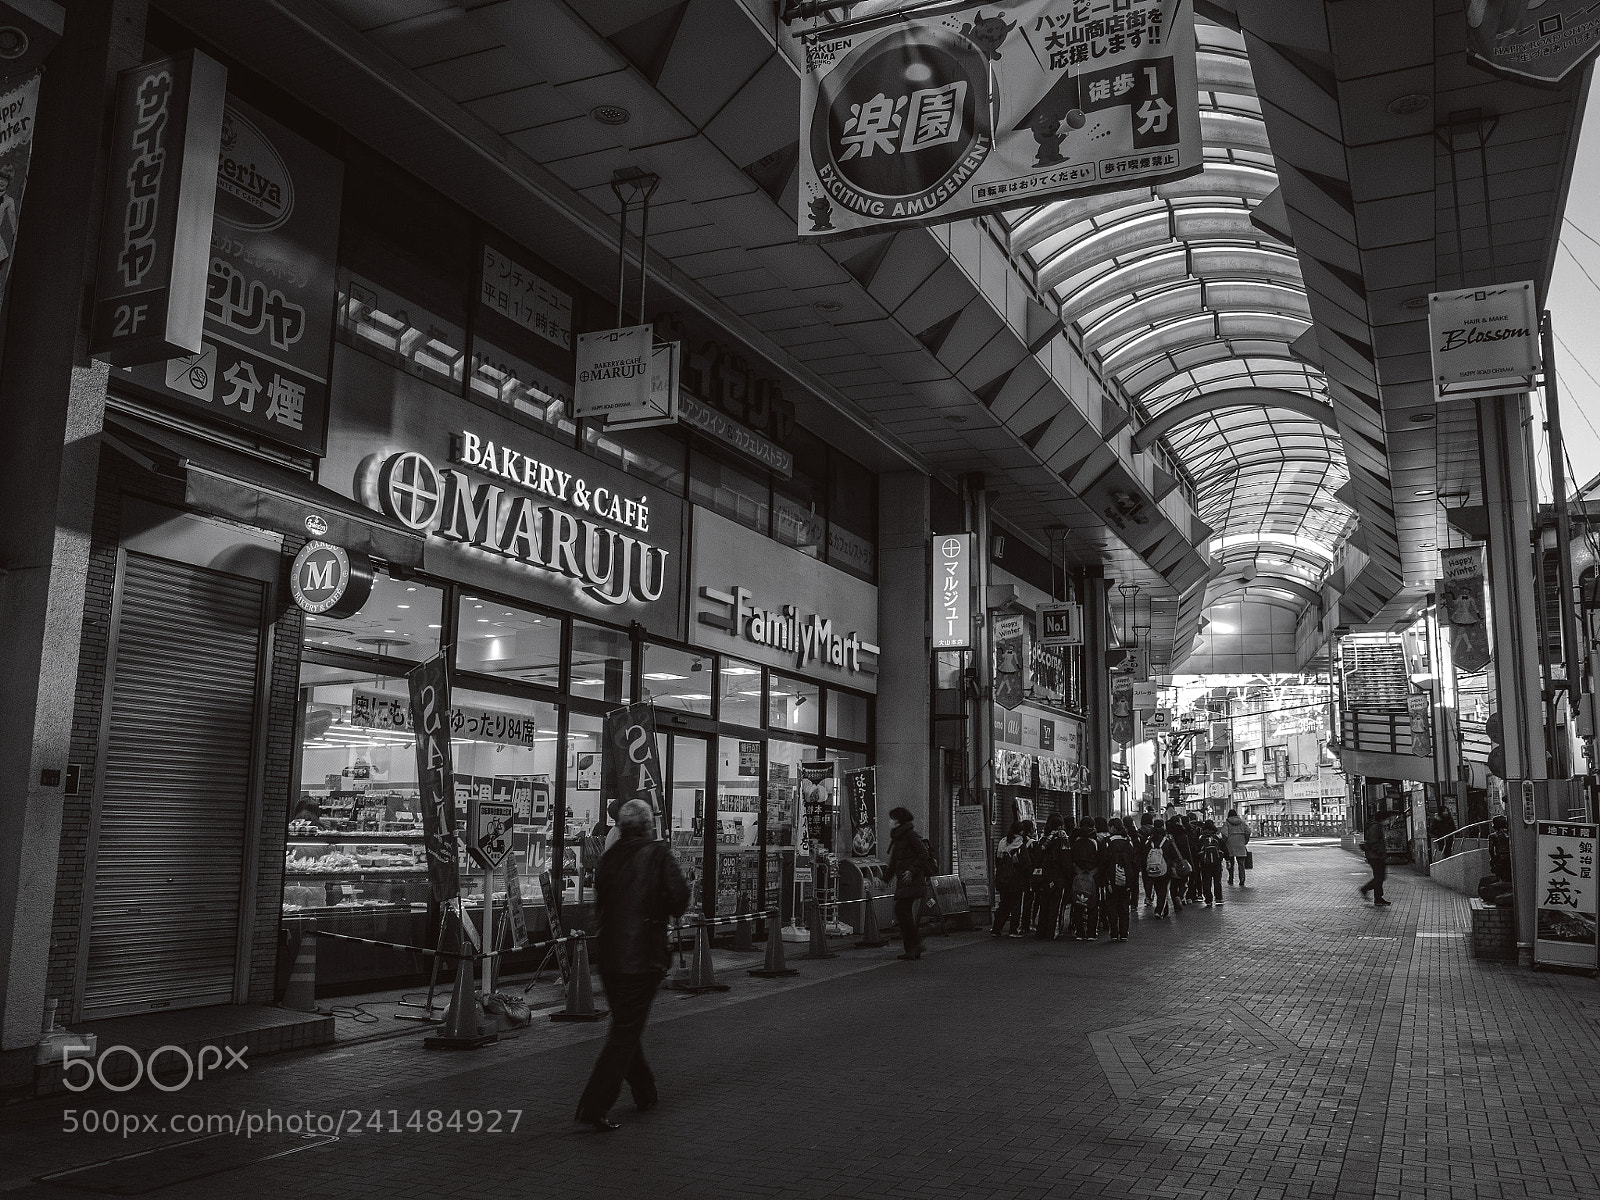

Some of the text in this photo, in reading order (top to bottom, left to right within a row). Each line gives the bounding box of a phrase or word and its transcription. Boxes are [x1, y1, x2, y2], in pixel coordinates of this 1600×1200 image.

[1044, 8, 1163, 51] 大山商店街を
[1530, 34, 1561, 49] ROAD
[806, 39, 852, 56] RAKUEN
[806, 52, 836, 64] OYAMA
[1049, 25, 1161, 70] 応援します!!
[0, 96, 24, 123] ppy
[838, 80, 968, 162] 楽園
[819, 134, 990, 217] EXCITING AMUSEMENT
[1104, 154, 1175, 174] 歩行喫煙禁止
[117, 71, 174, 288] サイゼリヤ
[977, 168, 1090, 198] 自転車はおりてください
[486, 252, 571, 311] ランチメニュー
[112, 304, 149, 338] 2F
[483, 281, 571, 346] 平日17時まで
[1440, 327, 1530, 352] Blossom
[590, 363, 647, 382] MARUJU
[594, 360, 620, 370] BAKERY
[222, 360, 306, 431] 分煙
[461, 430, 649, 534] BAKERY & CAFÉ
[444, 471, 670, 606] MARUJU
[303, 560, 337, 591] M
[1446, 565, 1478, 578] Winter
[1449, 557, 1473, 567] Happy
[294, 592, 317, 612] BAKERY
[943, 561, 959, 636] マルジュー
[735, 586, 861, 674] FamilyMart
[999, 627, 1021, 637] Winter
[1001, 621, 1018, 629] Happy
[1047, 615, 1067, 632] No.1
[1547, 826, 1591, 838] 地下1階
[1543, 846, 1582, 909] 文蔵
